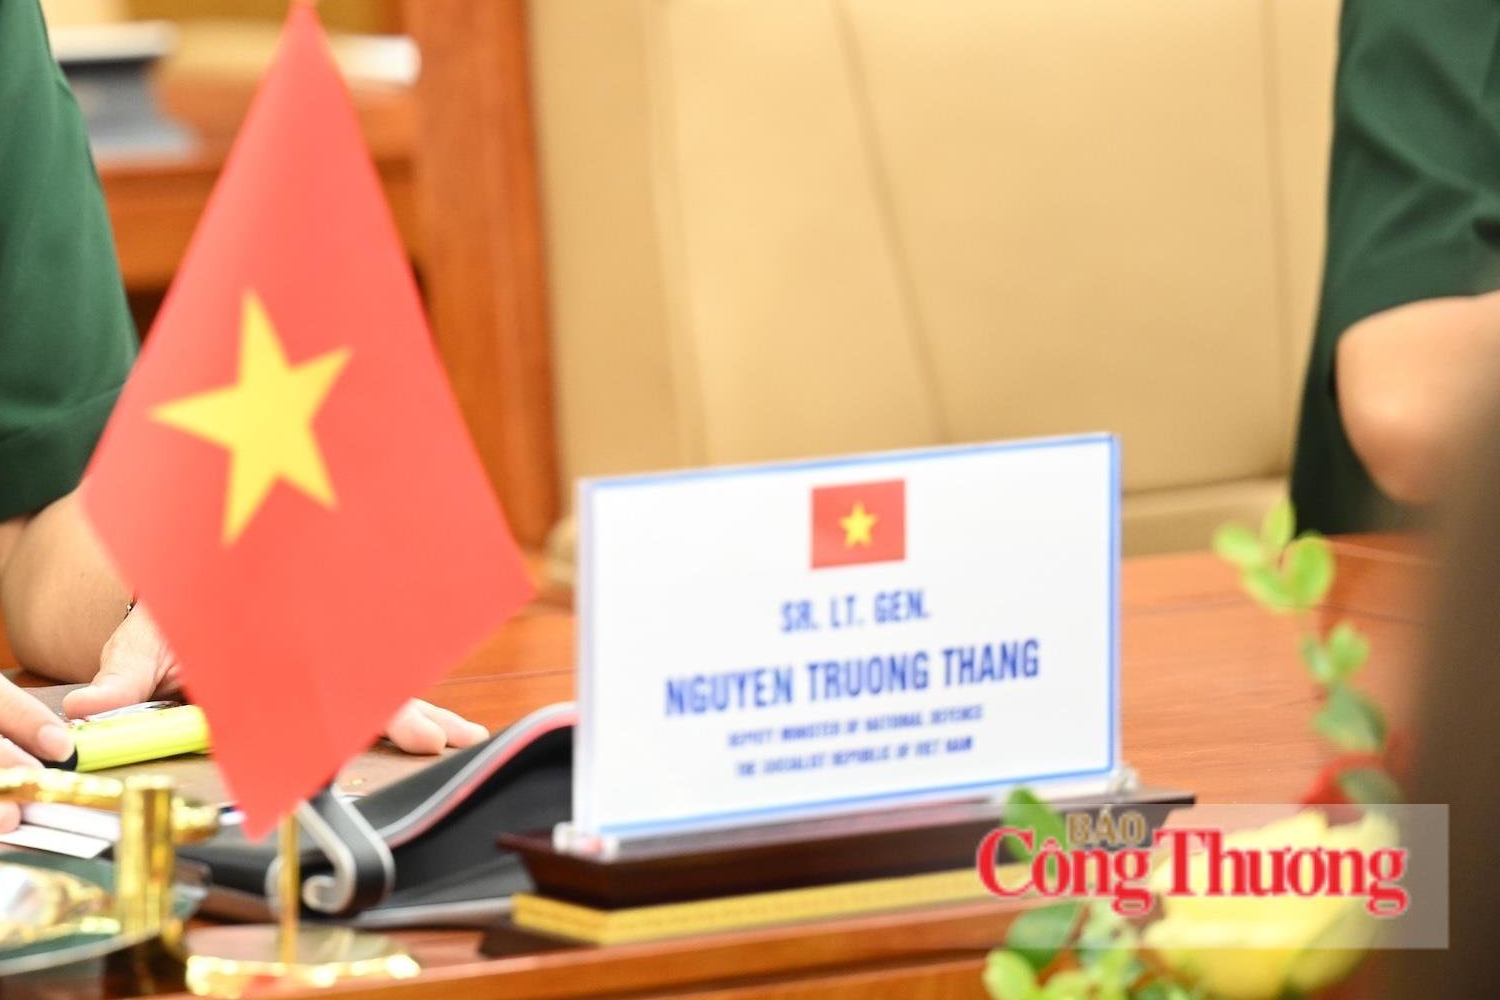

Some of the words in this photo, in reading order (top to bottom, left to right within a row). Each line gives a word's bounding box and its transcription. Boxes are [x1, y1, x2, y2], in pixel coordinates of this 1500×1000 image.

[781, 600, 819, 632] SR.
[830, 596, 865, 628] LT.
[874, 589, 931, 624] GEN.
[665, 666, 793, 716] NGUYEN
[807, 651, 929, 701] TRUONG
[942, 638, 1040, 687] THANG
